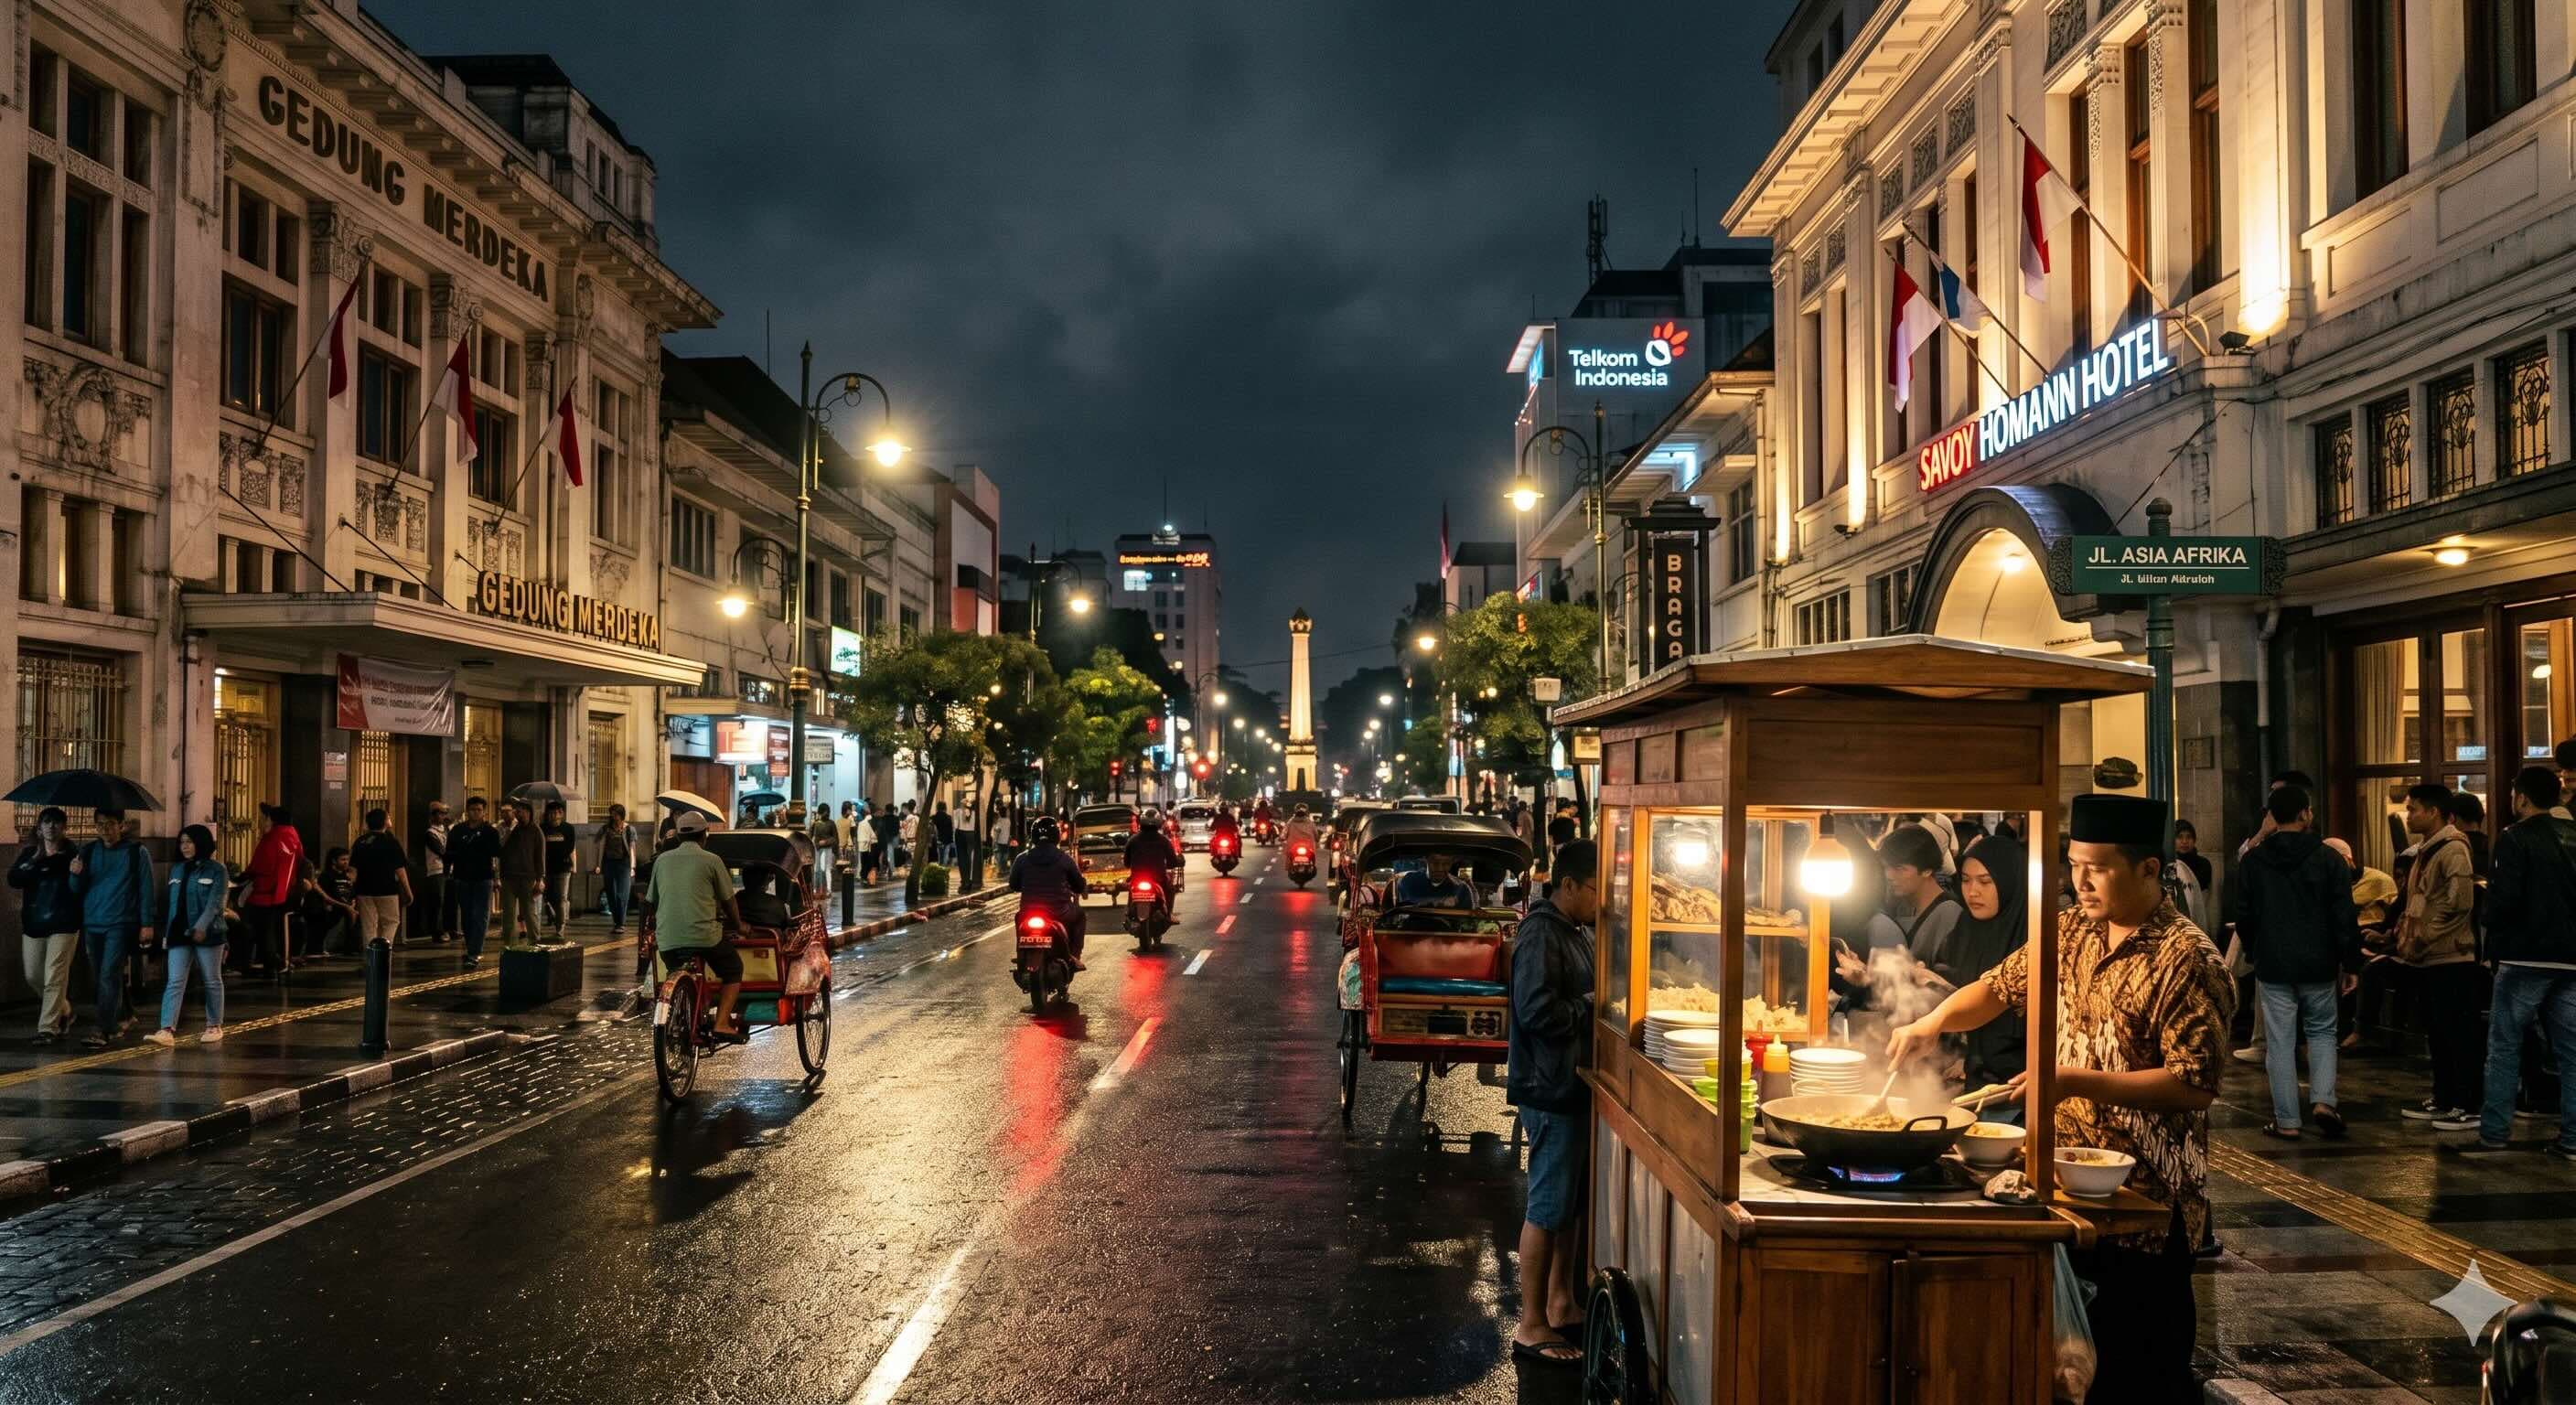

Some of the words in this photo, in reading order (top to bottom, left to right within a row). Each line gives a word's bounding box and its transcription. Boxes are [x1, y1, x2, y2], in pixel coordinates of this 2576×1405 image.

[258, 76, 405, 205] GEDUNG
[424, 184, 548, 303] MERDEKA
[1568, 349, 1638, 367] Telkom
[1575, 369, 1669, 386] Indonesia
[1920, 424, 1975, 491] SAVOY
[1979, 366, 2076, 461] HOMANN
[2081, 318, 2168, 409] HOTEL
[2088, 547, 2117, 563] JL.
[2120, 547, 2169, 563] ASIA
[2173, 547, 2247, 563] AFRIKA
[482, 571, 570, 628] GEDUNG
[578, 596, 660, 649] MERDEKA
[1667, 554, 1683, 659] BRAGA
